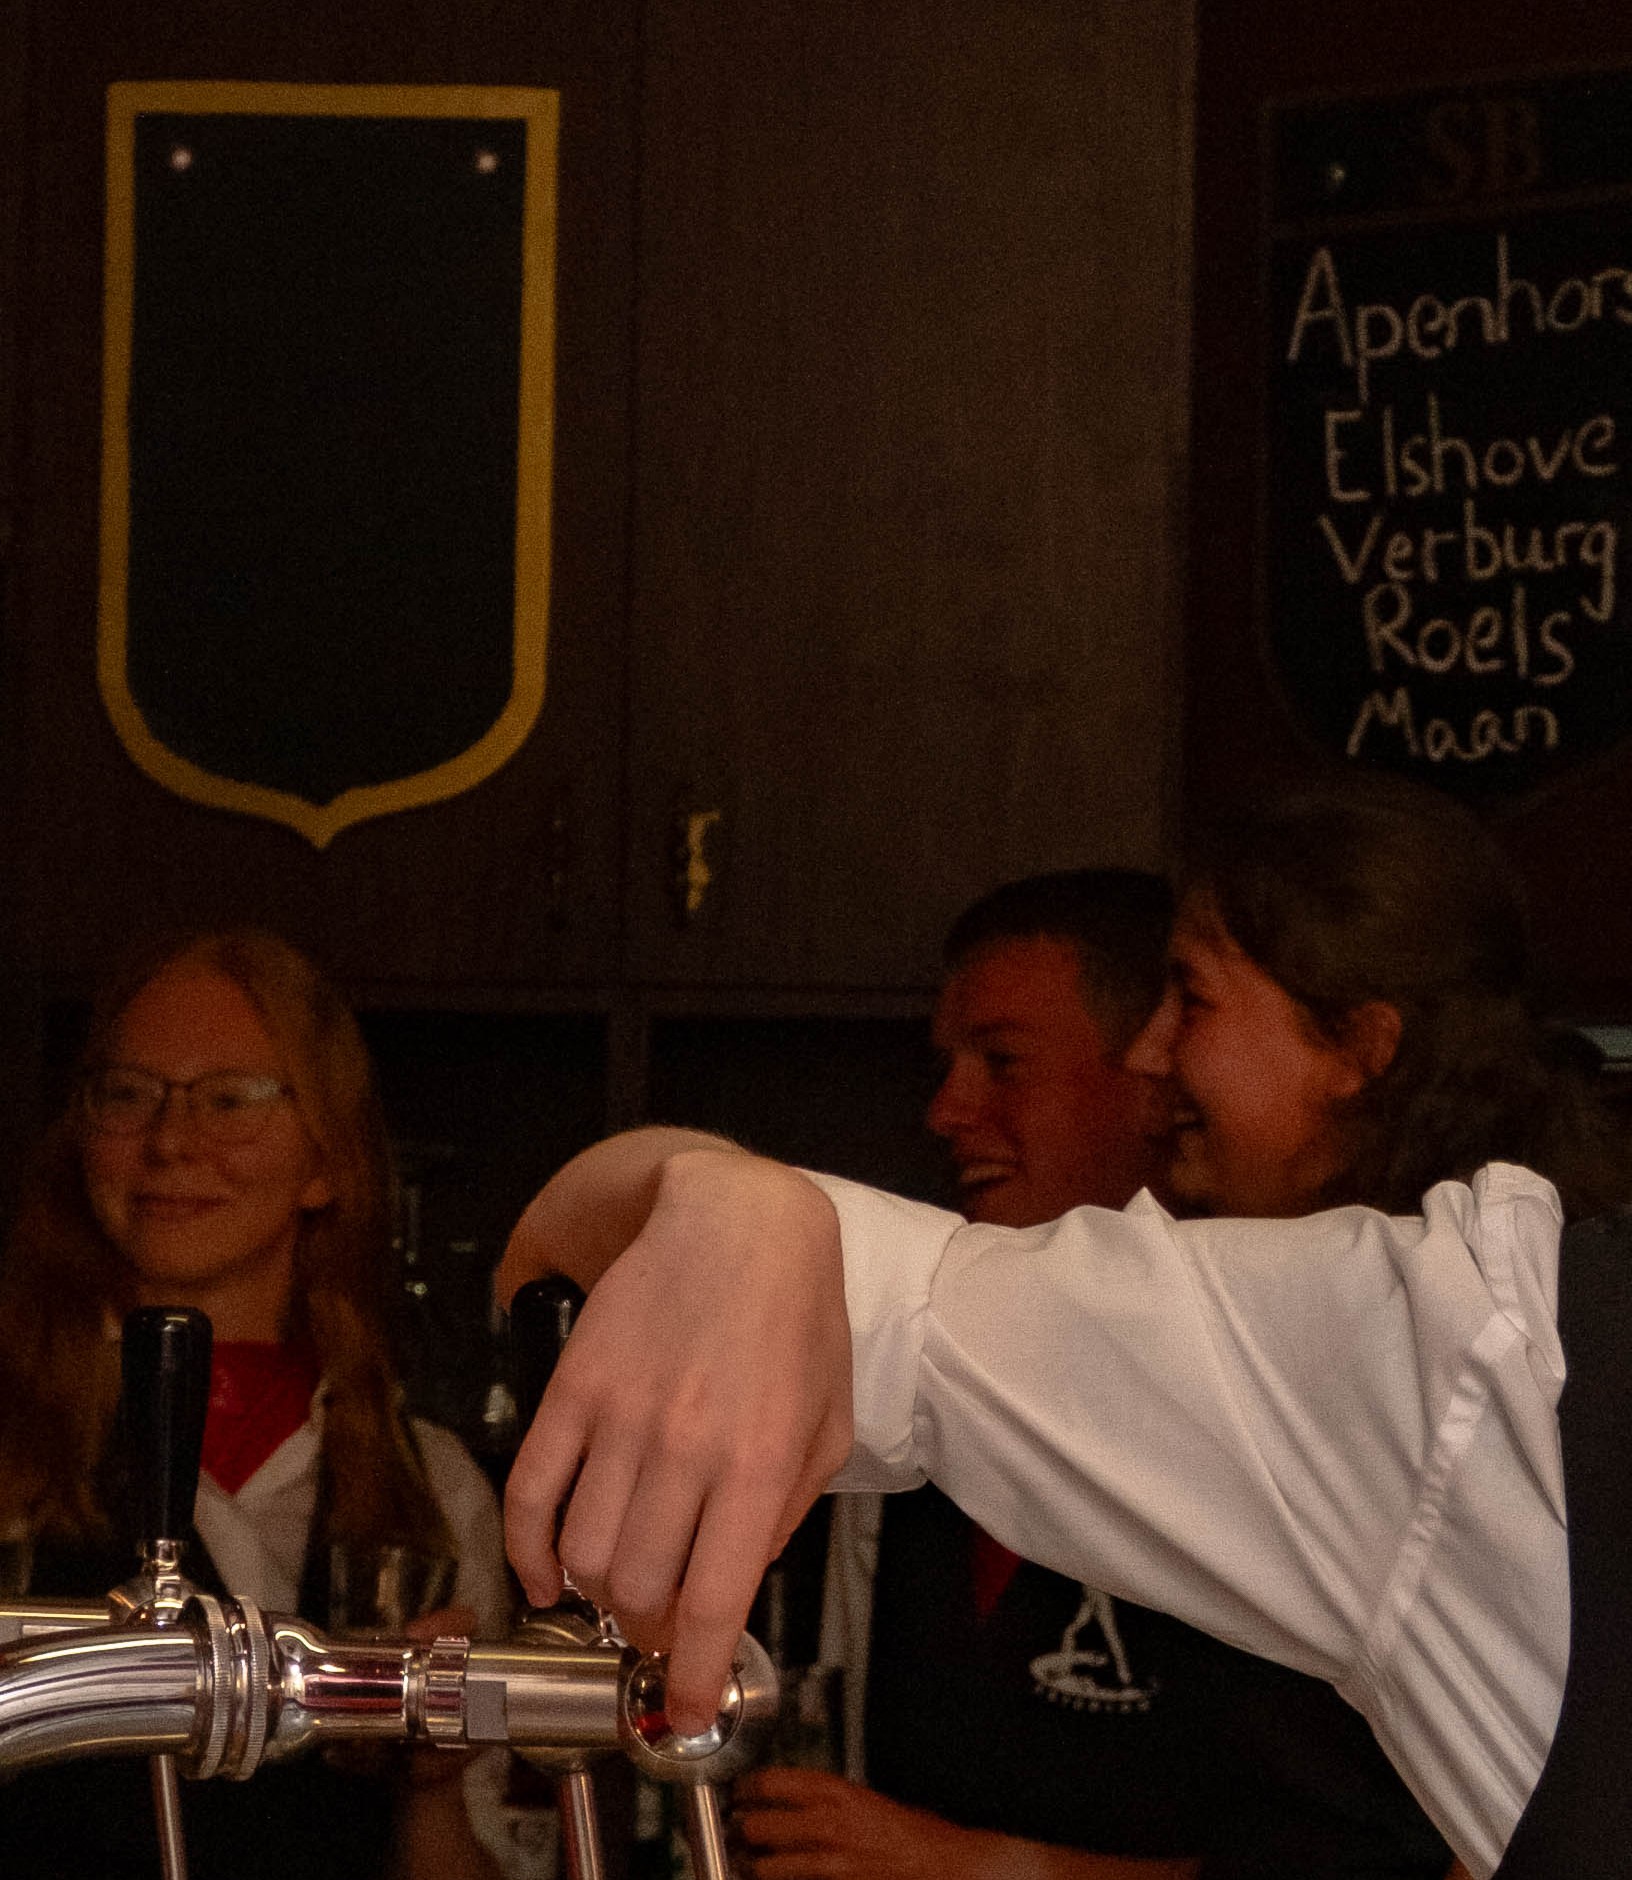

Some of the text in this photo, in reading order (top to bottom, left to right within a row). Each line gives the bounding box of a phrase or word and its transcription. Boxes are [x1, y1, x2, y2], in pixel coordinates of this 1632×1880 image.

[1323, 391, 1620, 503] Elshove
[1316, 497, 1619, 625] Verburg
[1361, 580, 1578, 688] Roels
[1345, 687, 1562, 763] Maan
